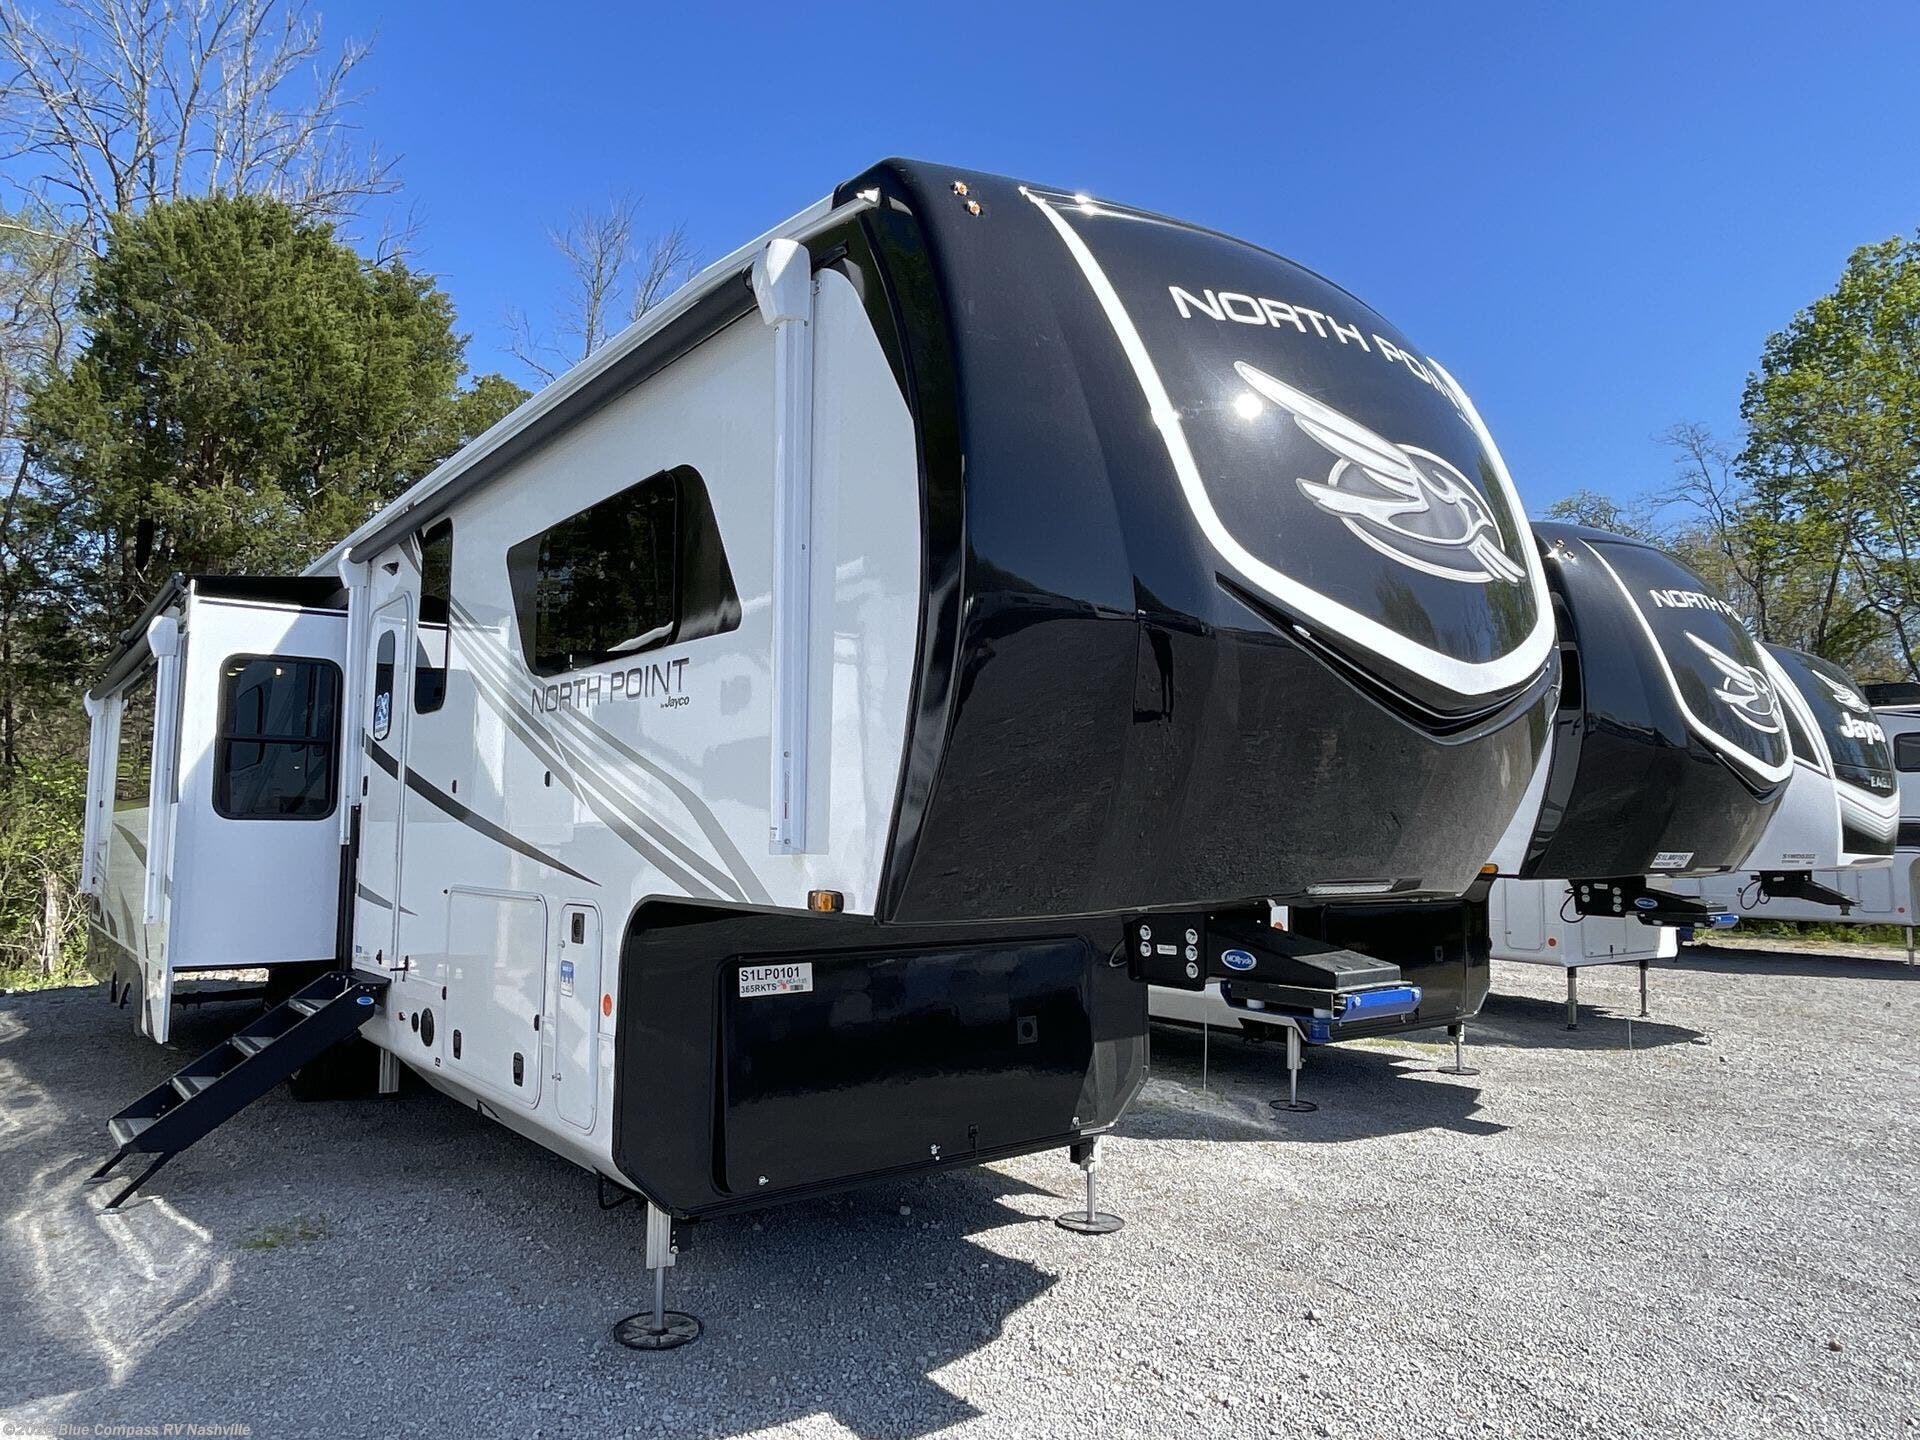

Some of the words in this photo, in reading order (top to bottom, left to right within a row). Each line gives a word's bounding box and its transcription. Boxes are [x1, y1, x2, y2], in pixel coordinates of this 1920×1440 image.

[1168, 285, 1371, 353] NORTH
[1649, 589, 1723, 614] NORTH
[531, 677, 602, 716] NORTH
[610, 657, 690, 703] POINT
[665, 696, 690, 709] Jayco
[740, 966, 800, 982] S1LP0101
